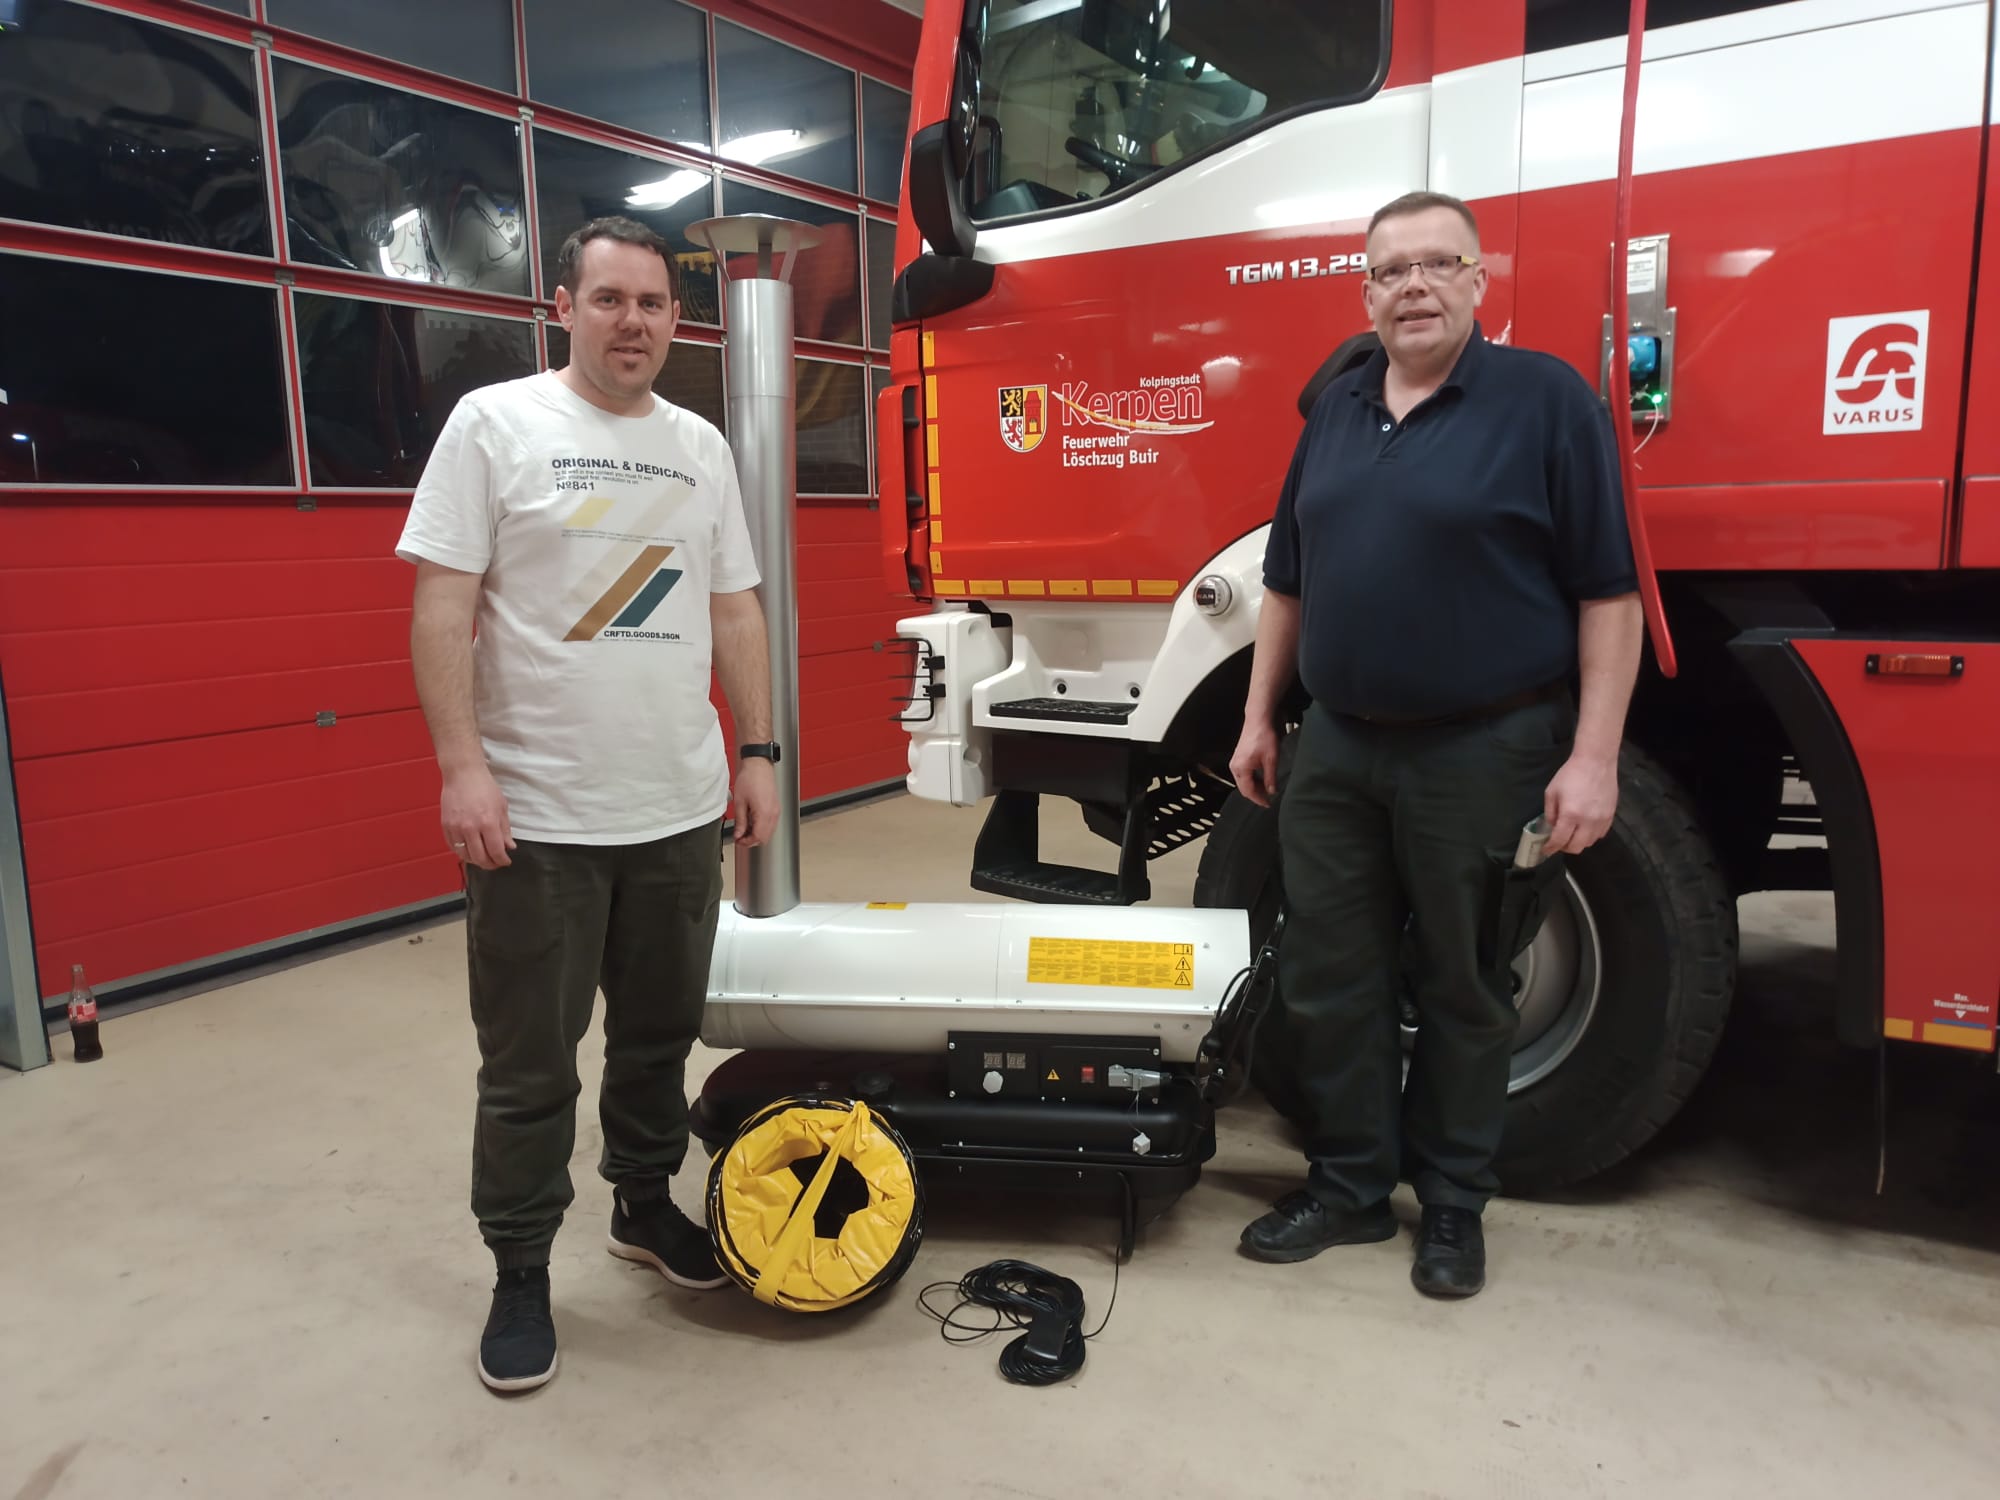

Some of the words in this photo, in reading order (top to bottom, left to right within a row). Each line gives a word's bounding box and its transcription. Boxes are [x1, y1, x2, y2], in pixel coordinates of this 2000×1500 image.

[1225, 261, 1284, 285] TGM
[1289, 252, 1368, 279] 13.29
[1140, 373, 1200, 388] Kolpingstadt
[1062, 381, 1202, 433] Kerpen
[1833, 408, 1914, 425] VARUS
[1063, 432, 1130, 449] Feuerwehr
[1063, 450, 1124, 468] Löschzug
[1129, 449, 1159, 464] Buir
[552, 458, 618, 469] ORIGINAL
[622, 461, 631, 471] &
[635, 462, 696, 487] DEDICATED
